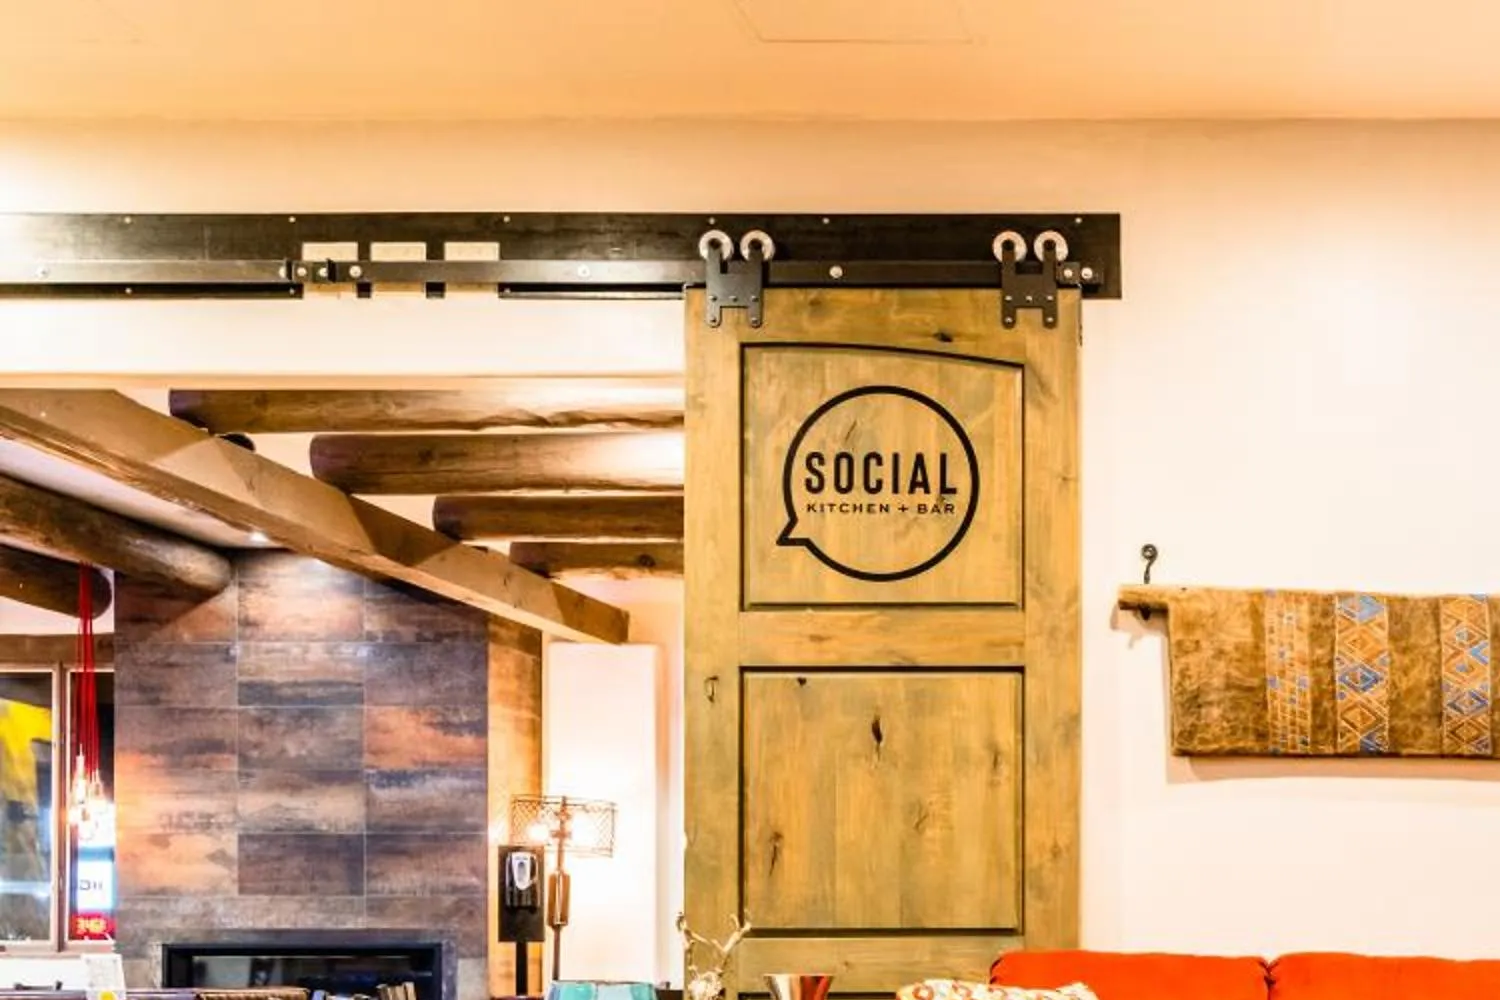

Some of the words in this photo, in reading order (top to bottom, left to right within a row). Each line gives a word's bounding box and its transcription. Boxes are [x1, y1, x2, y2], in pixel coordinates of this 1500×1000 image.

[804, 451, 958, 495] SOCIAL
[806, 503, 890, 514] KITCHEN
[917, 503, 956, 514] BAR
